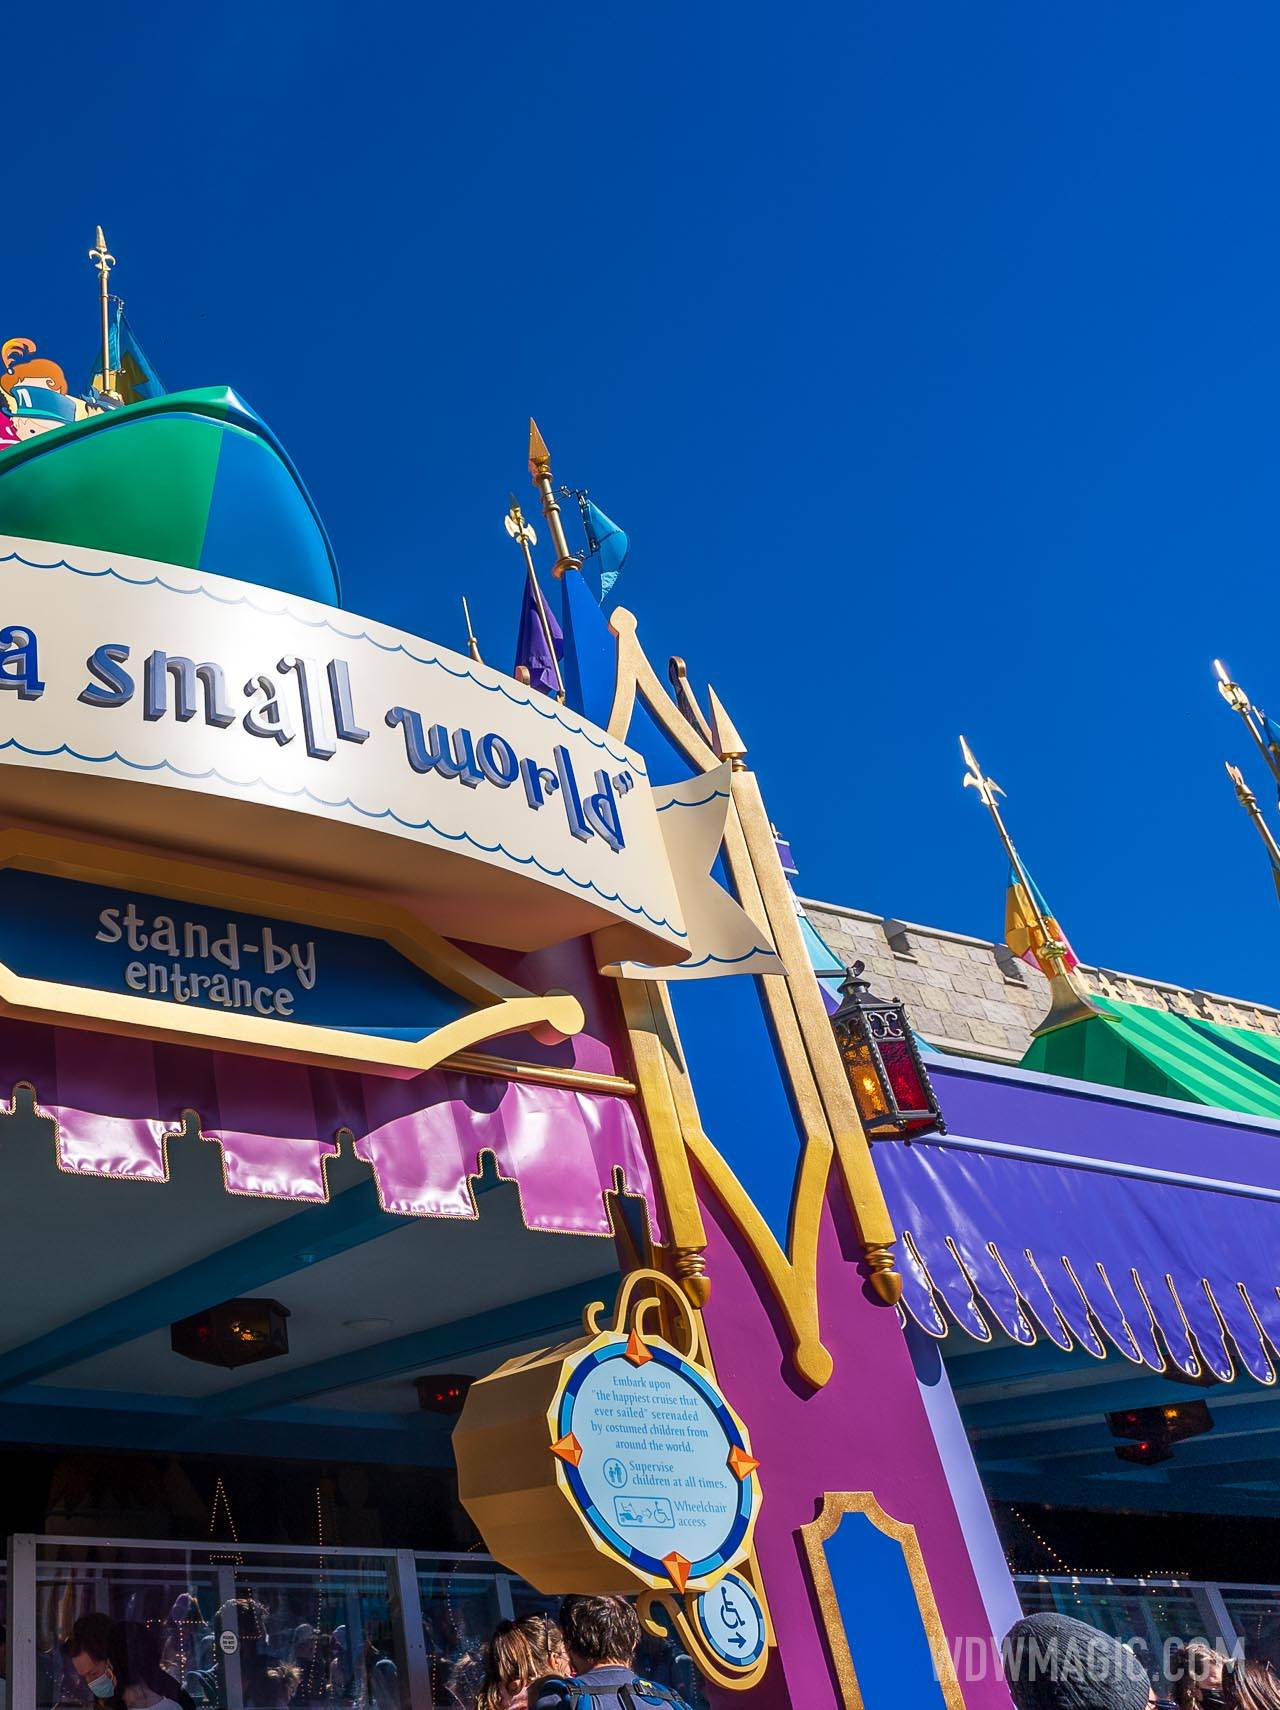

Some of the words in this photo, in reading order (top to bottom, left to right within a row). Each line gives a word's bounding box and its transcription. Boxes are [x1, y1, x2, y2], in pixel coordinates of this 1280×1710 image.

[77, 643, 370, 761] small
[95, 903, 317, 989] stand-by
[125, 961, 295, 1015] entrance
[612, 1376, 646, 1387] Embark
[649, 1380, 671, 1391] upon
[612, 1390, 650, 1405] happiest
[652, 1396, 678, 1405] cruise
[680, 1395, 698, 1406] that
[594, 1408, 613, 1417] ever
[651, 1410, 699, 1421] serenaded
[591, 1420, 602, 1434] by
[605, 1424, 648, 1434] costumed
[650, 1424, 685, 1436] children
[687, 1425, 709, 1438] from
[615, 1439, 647, 1450] around
[649, 1440, 664, 1450] the
[665, 1442, 694, 1453] world.
[629, 1461, 674, 1474] Supervise
[632, 1474, 670, 1486] children
[673, 1478, 684, 1487] at
[685, 1476, 696, 1488] all
[698, 1478, 728, 1489] times.
[674, 1500, 727, 1513] Wheelchair
[678, 1518, 706, 1527] access
